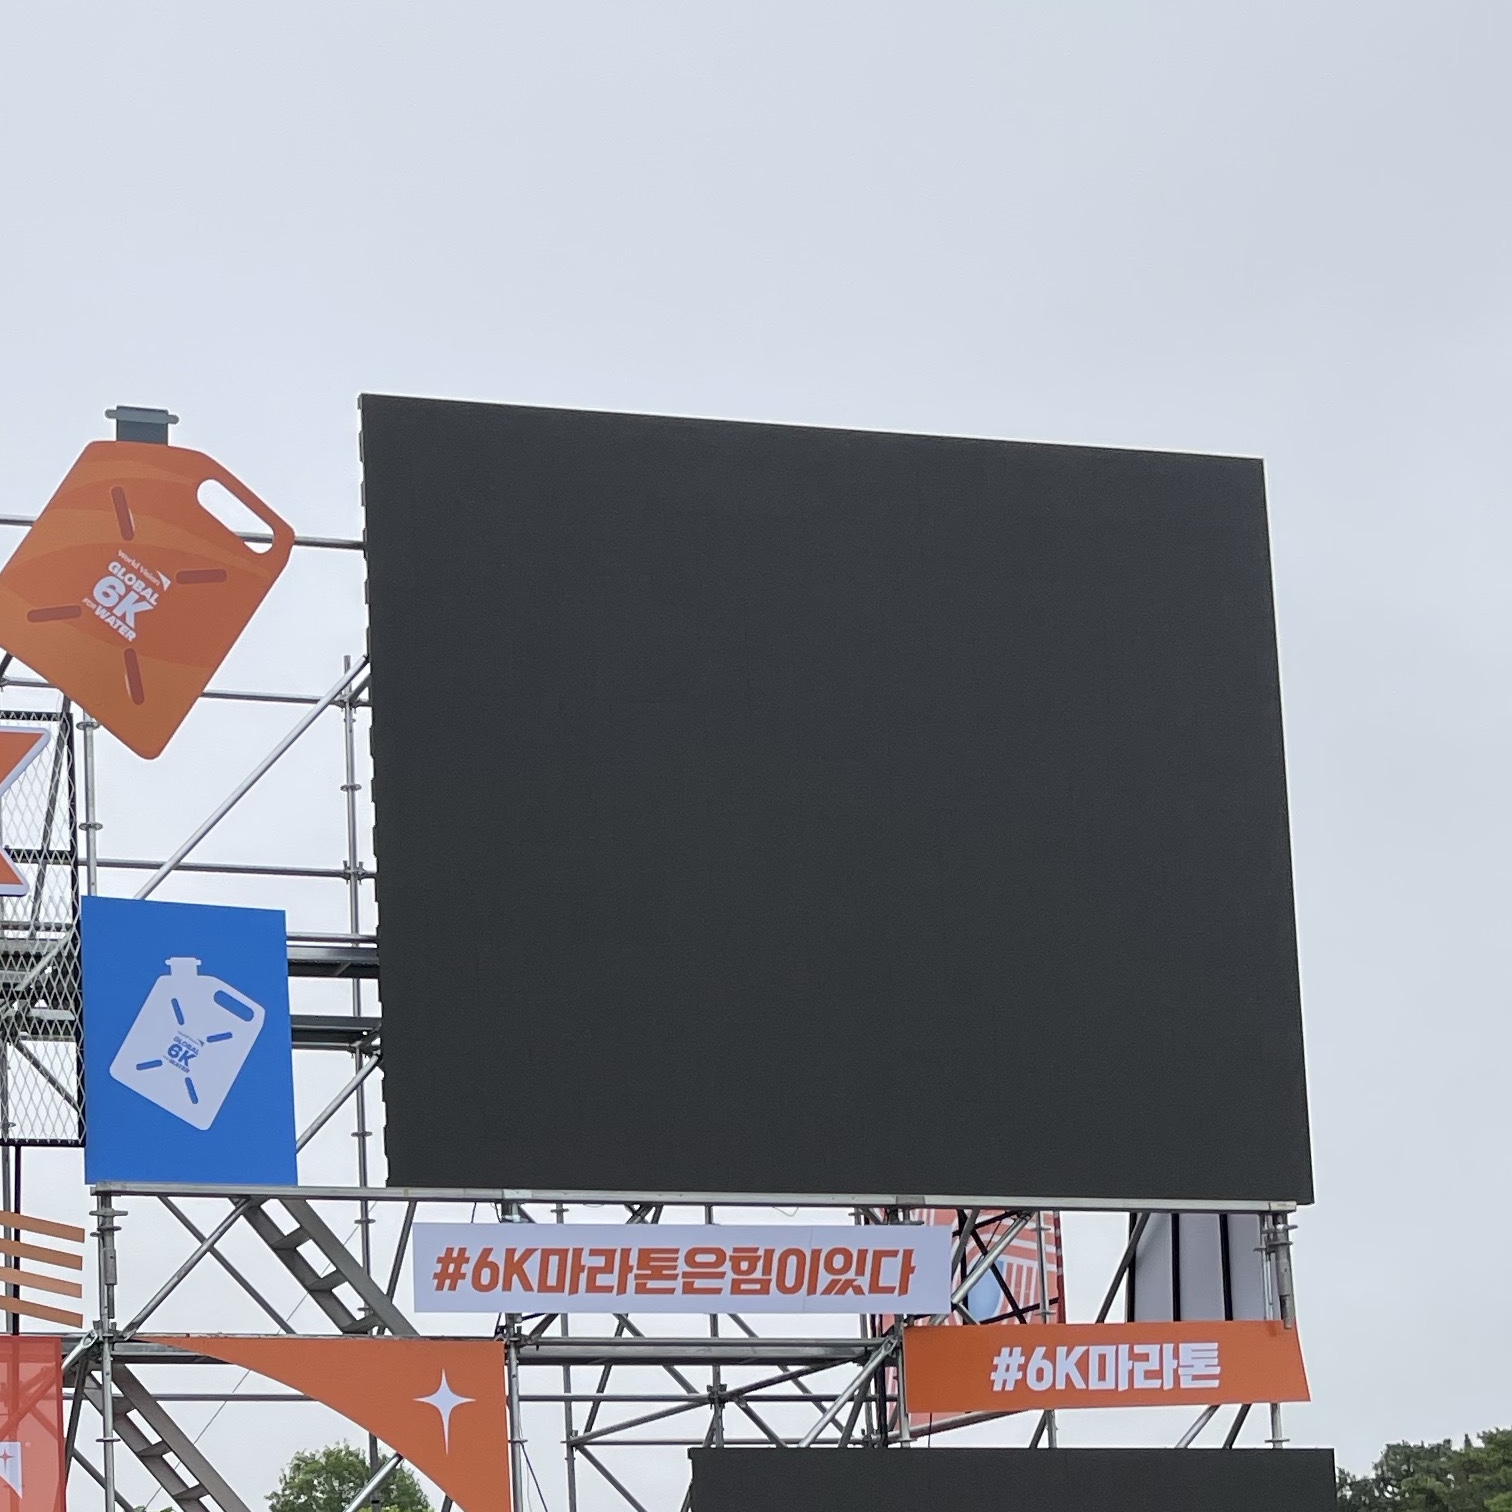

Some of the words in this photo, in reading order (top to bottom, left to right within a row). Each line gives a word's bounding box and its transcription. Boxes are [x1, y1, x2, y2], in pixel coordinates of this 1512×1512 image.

[93, 576, 154, 629] 6K
[108, 561, 159, 606] GLOBAL
[94, 605, 136, 641] WATER
[168, 1044, 196, 1067] 6K
[432, 1246, 917, 1298] #6K마라톤은힘이있다
[990, 1341, 1222, 1393] #6K마라톤
